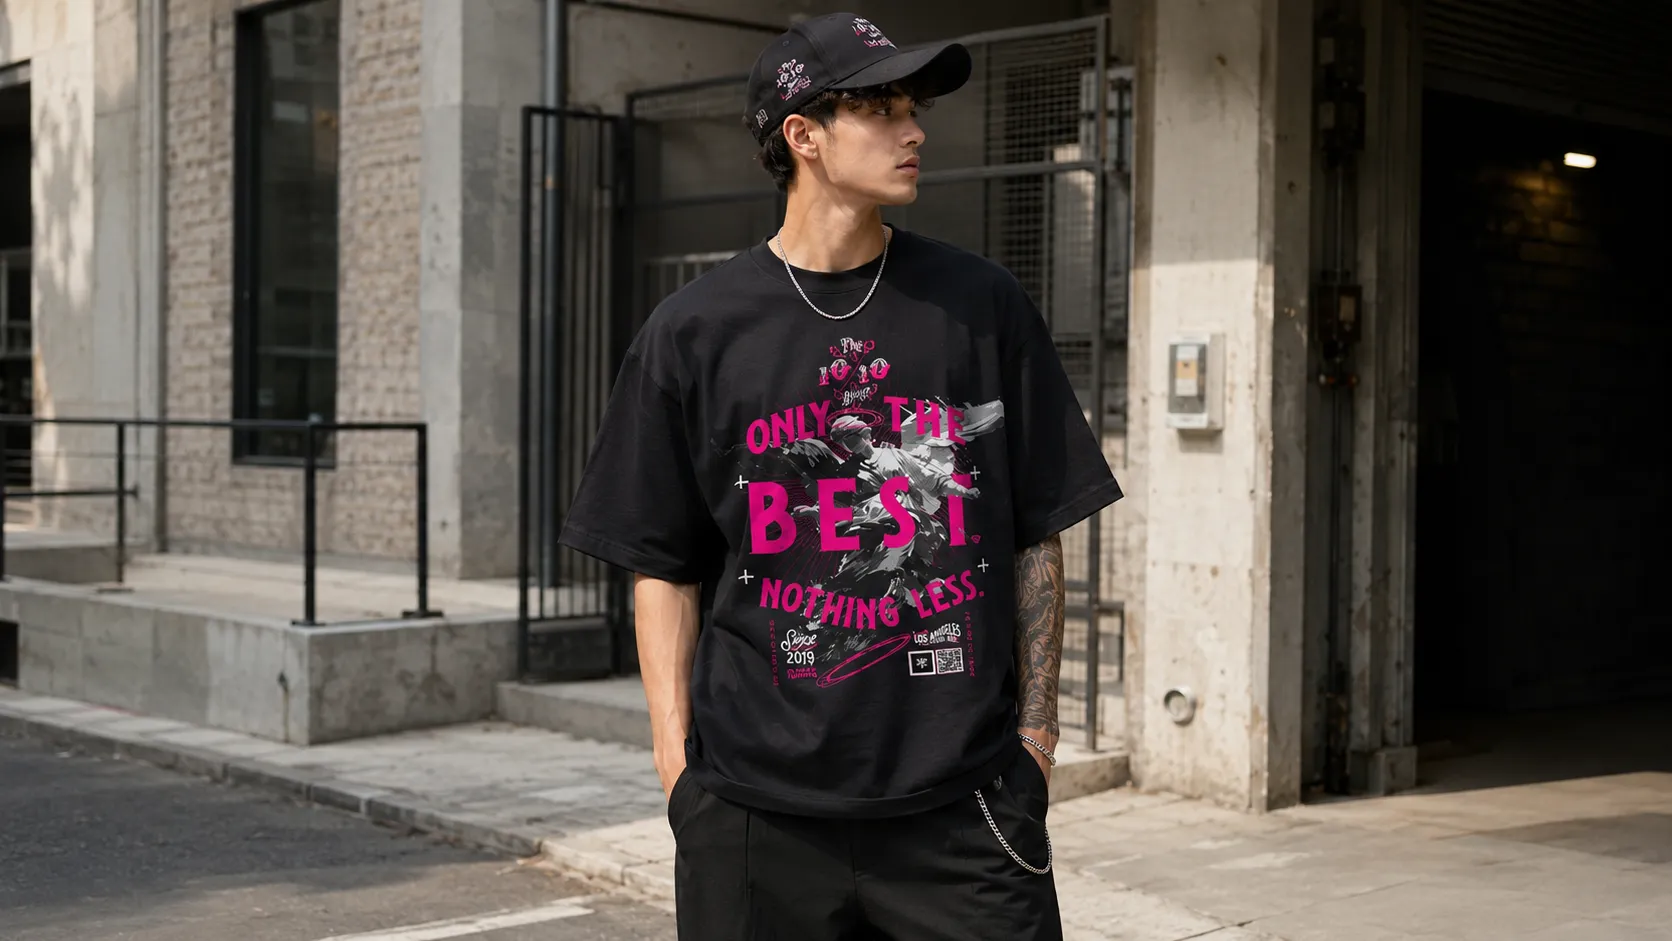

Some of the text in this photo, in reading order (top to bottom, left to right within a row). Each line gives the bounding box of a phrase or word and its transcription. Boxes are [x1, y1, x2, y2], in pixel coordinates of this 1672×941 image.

[746, 396, 966, 454] ONLY THE
[760, 569, 985, 630] NOTHING LESS.
[786, 651, 815, 667] 2019
